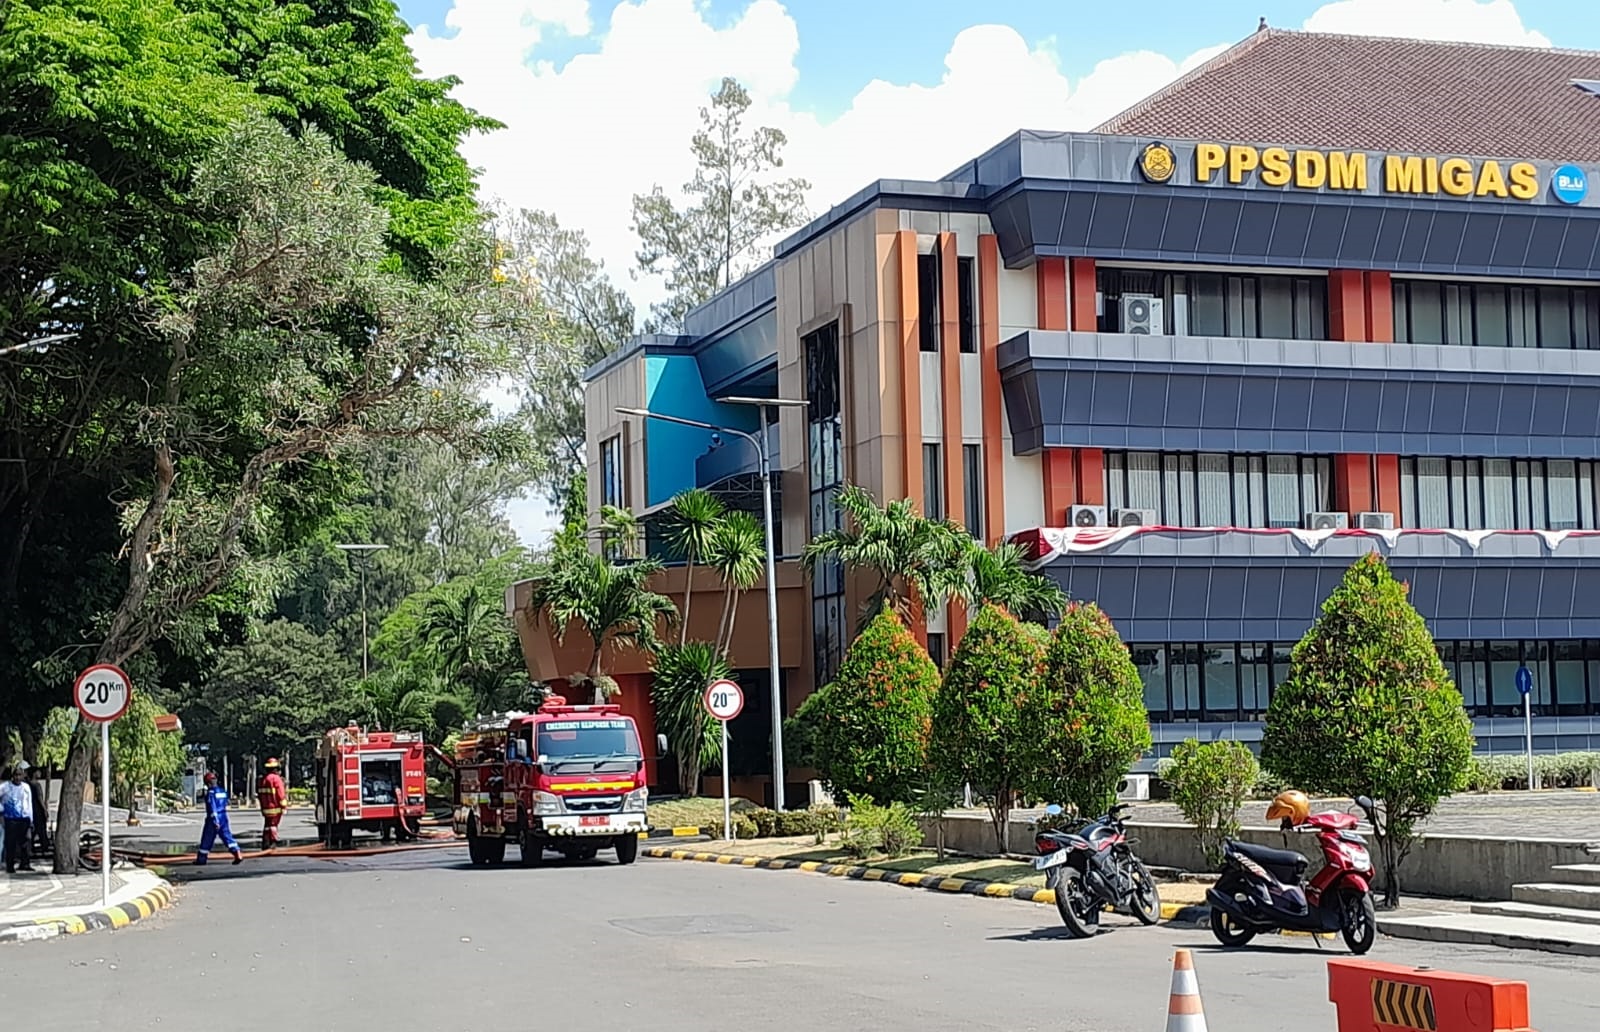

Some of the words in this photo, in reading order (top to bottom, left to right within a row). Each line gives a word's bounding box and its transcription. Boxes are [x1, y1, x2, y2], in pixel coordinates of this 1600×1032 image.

[1196, 143, 1367, 190] PPSDM
[1386, 154, 1538, 199] MIGAS
[84, 682, 109, 704] 20
[712, 692, 727, 708] 20
